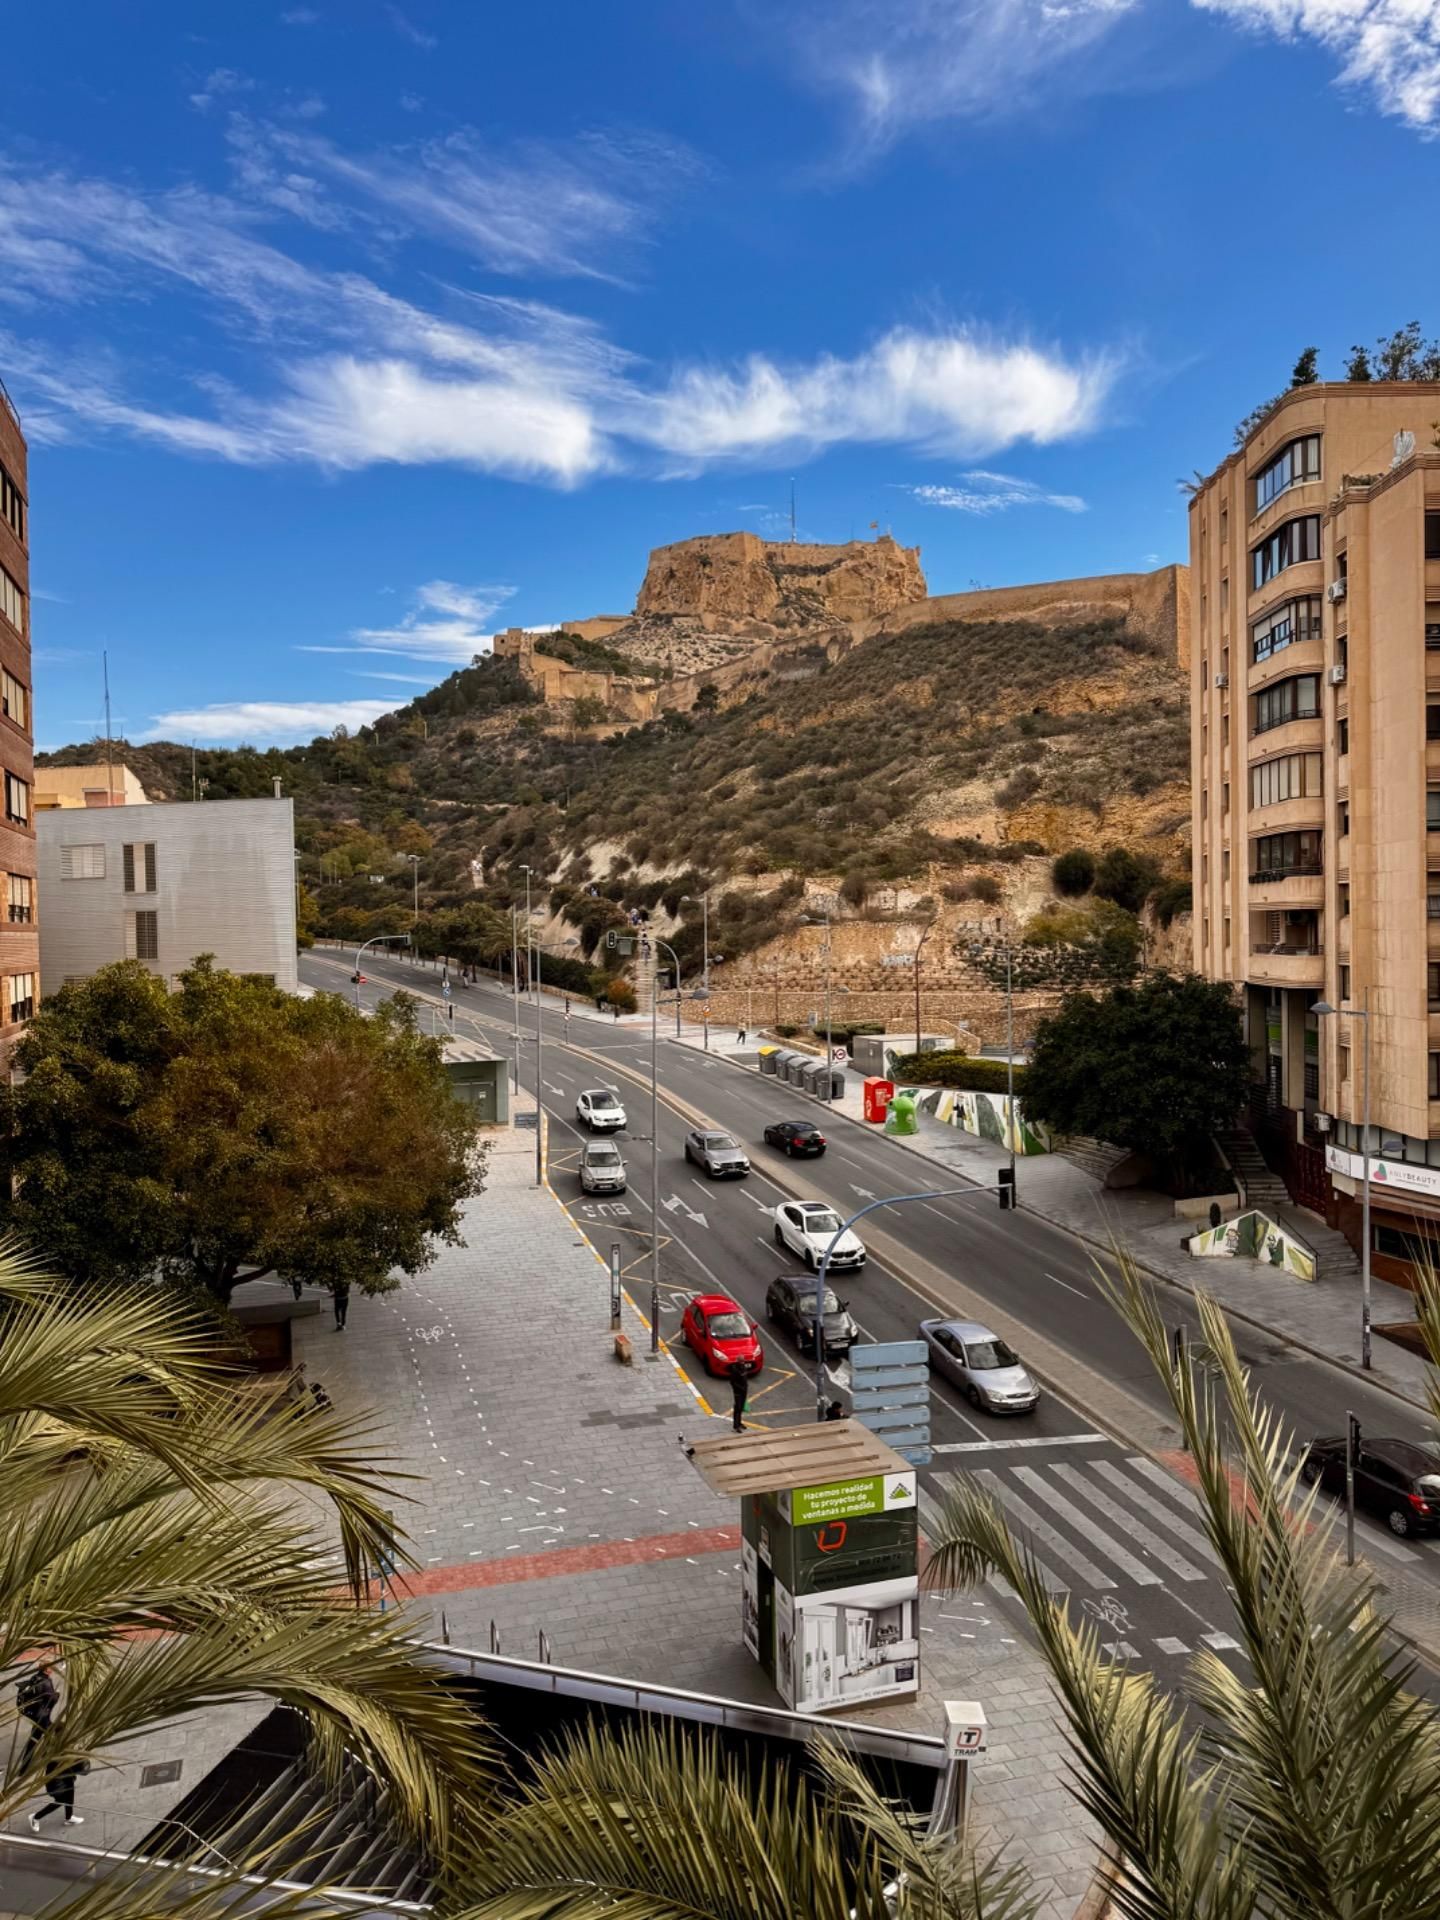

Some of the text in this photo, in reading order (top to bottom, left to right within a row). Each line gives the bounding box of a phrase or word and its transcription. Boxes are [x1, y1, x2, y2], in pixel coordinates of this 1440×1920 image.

[582, 1203, 632, 1217] BUS
[803, 1483, 873, 1501] Hacemos realidad
[810, 1493, 867, 1508] tu proyecto de
[803, 1507, 839, 1519] ventanas
[847, 1501, 875, 1512] medida
[964, 1732, 977, 1744] T
[953, 1749, 978, 1757] TRAM
